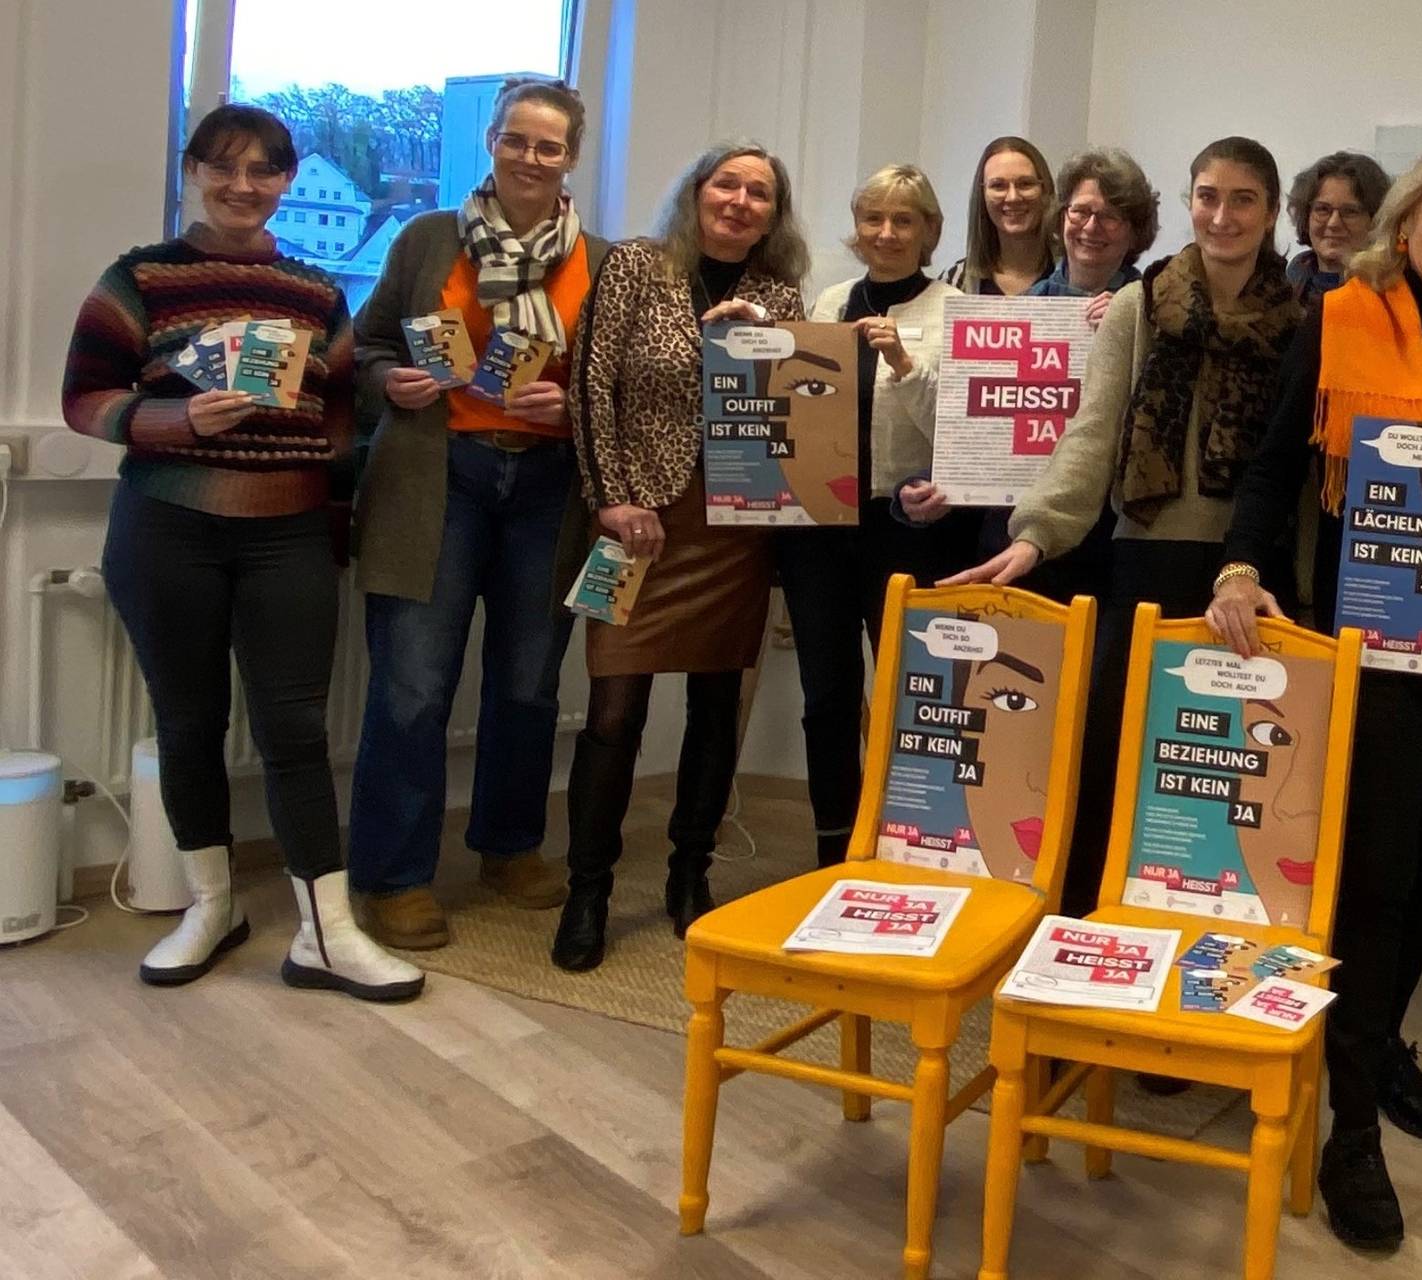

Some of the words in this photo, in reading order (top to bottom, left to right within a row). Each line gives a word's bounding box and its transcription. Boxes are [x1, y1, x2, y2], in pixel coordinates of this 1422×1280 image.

[965, 326, 1023, 349] NUR
[1031, 347, 1062, 370] JA
[714, 376, 738, 389] EIN
[980, 386, 1074, 409] HEISST
[726, 399, 776, 412] OUTFIT
[711, 424, 733, 437] IST
[738, 424, 771, 437] KEIN
[1027, 419, 1058, 442] JA
[770, 442, 789, 455] JA
[1397, 442, 1418, 451] DOCH
[1369, 484, 1397, 501] EIN
[1354, 543, 1378, 559] IST
[1366, 630, 1379, 640] JA
[1382, 639, 1416, 651] HEISST
[1226, 661, 1241, 669] MAL
[1255, 674, 1266, 682] DU
[909, 677, 934, 693] EIN
[1211, 680, 1232, 689] DOCH
[1236, 683, 1257, 692] AUCH
[918, 705, 972, 726] OUTFIT
[1180, 712, 1219, 731] EINE
[900, 733, 922, 749] IST
[927, 738, 962, 755] KEIN
[1159, 743, 1259, 770] BEZIEHUNG
[958, 764, 977, 780] JA
[1160, 773, 1187, 791] IST
[1190, 778, 1230, 797] KEIN
[1233, 804, 1255, 823] JA
[887, 823, 906, 836] NUR
[907, 825, 919, 836] JA
[959, 829, 971, 840] JA
[921, 836, 952, 849] HEISST
[1143, 865, 1166, 878] NUR
[1167, 868, 1181, 880] JA
[1224, 872, 1237, 884] JA
[1182, 879, 1218, 892] HEISST
[853, 891, 900, 903] NUR
[902, 902, 927, 910] JA
[853, 909, 934, 922] HEISST
[887, 922, 913, 932] JA
[1062, 931, 1111, 946] NUR
[1116, 945, 1140, 956] JA
[1066, 953, 1148, 969] HEISST
[1102, 970, 1129, 980] JA
